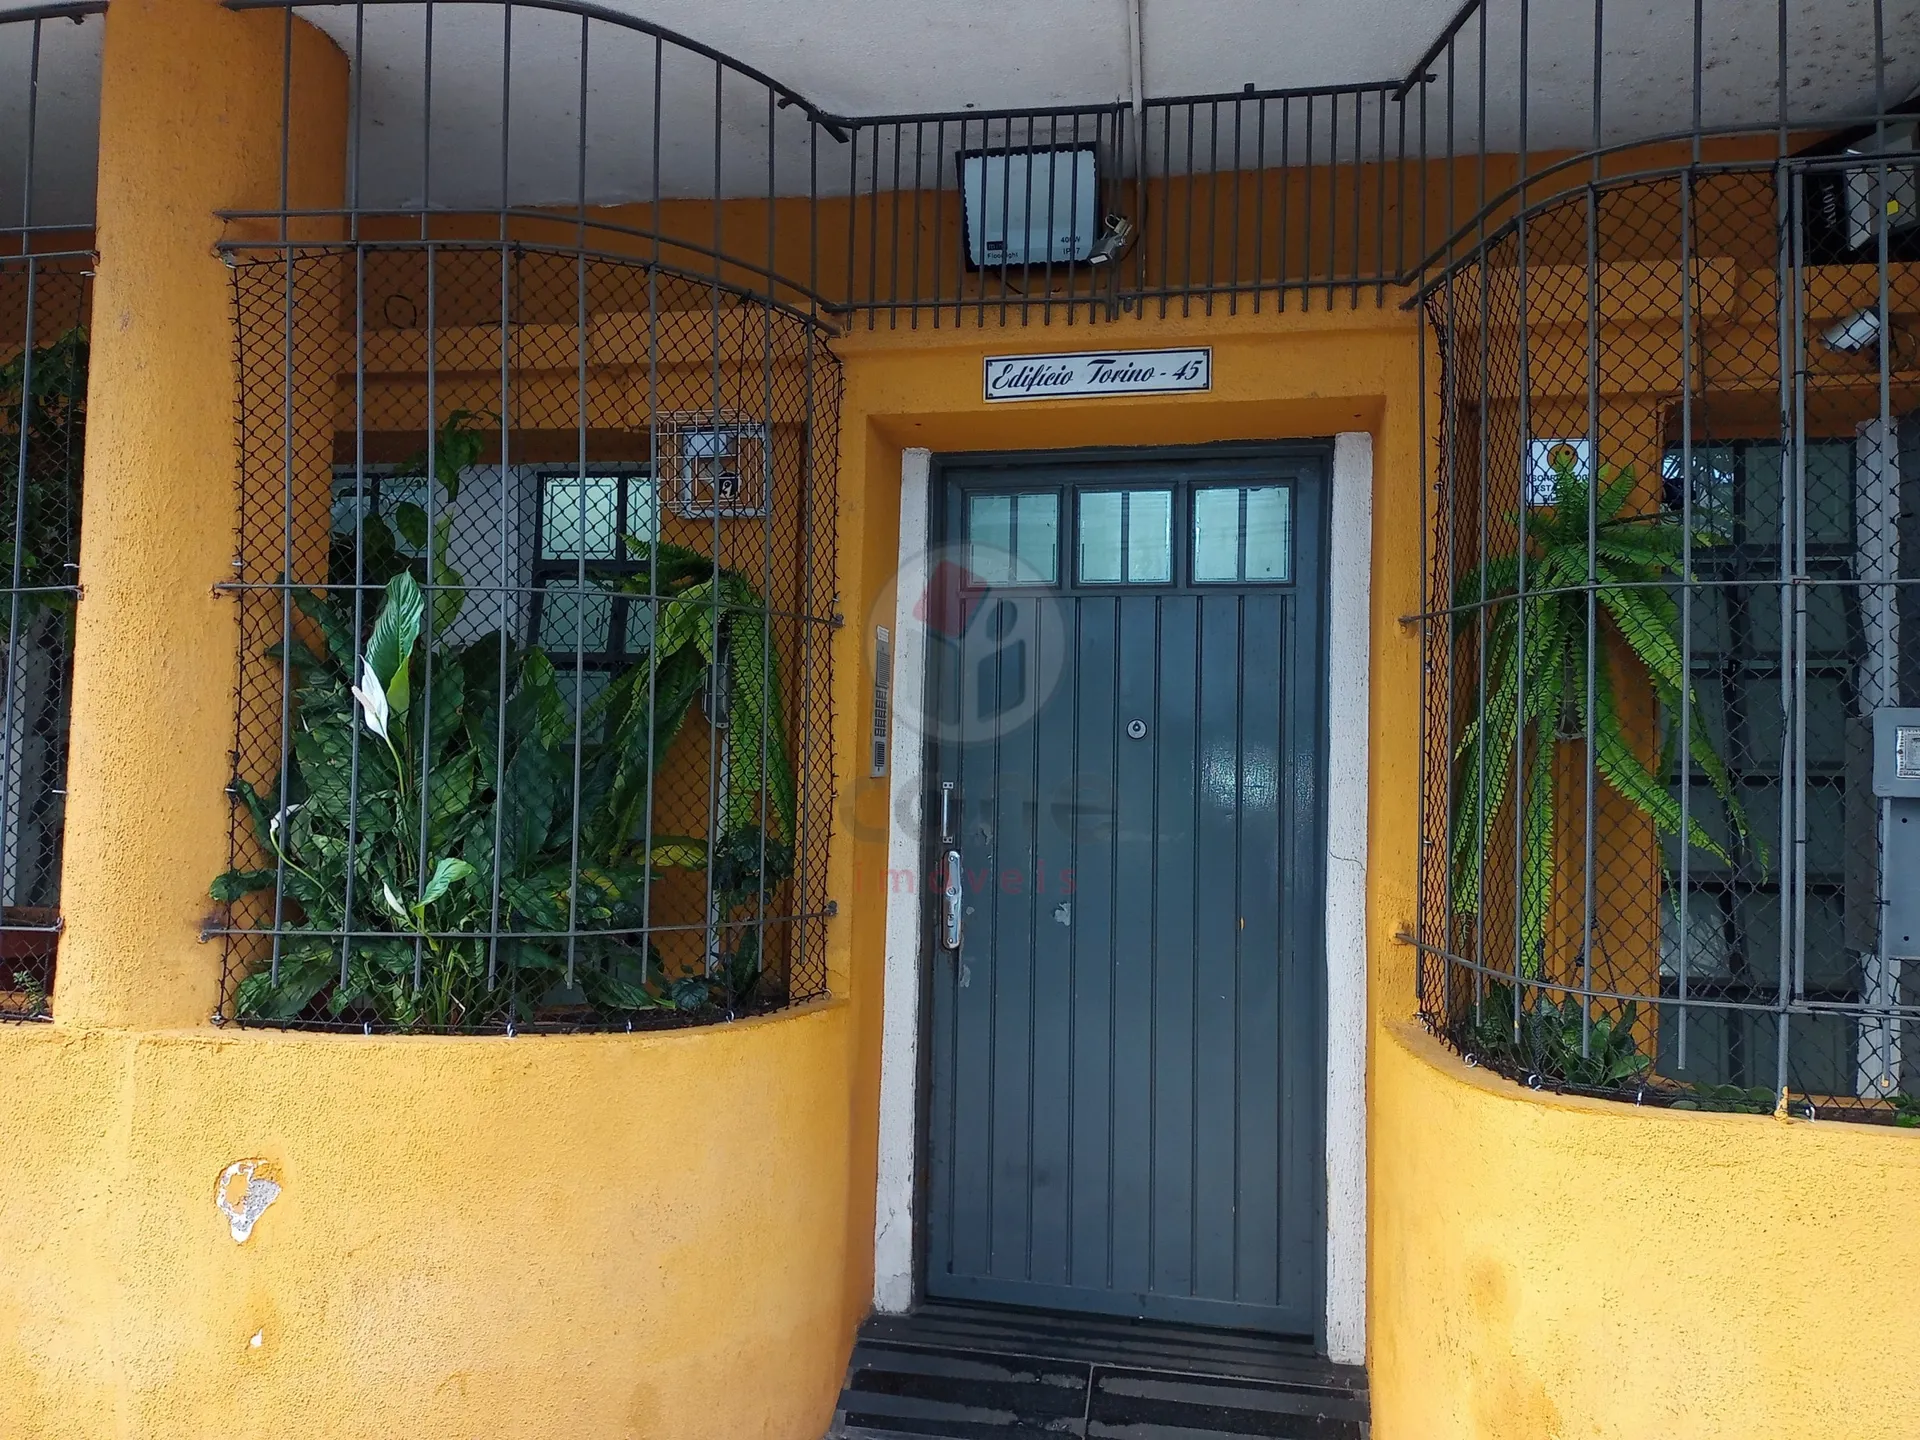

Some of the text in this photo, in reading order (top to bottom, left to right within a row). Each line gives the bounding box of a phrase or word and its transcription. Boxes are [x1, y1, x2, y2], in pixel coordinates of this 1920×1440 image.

[1063, 247, 1081, 255] IP7
[991, 362, 1074, 393] Edifício
[1087, 358, 1156, 385] Torino
[1171, 359, 1204, 381] 45
